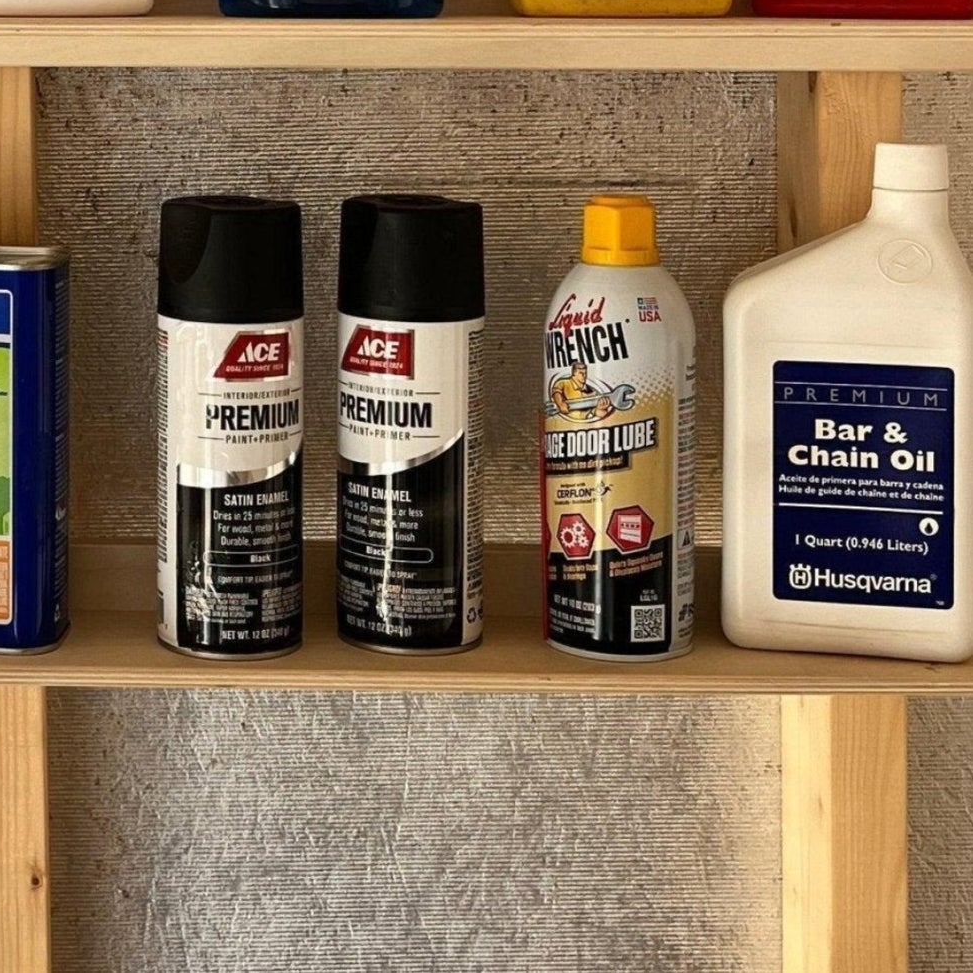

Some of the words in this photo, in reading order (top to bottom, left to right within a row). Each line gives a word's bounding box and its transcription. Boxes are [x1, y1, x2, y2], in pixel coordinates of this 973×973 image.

[548, 293, 605, 339] Liquid
[639, 311, 662, 323] USA
[237, 342, 281, 363] ACE
[357, 335, 400, 359] ACE
[784, 387, 938, 407] PREMIUM
[206, 398, 299, 431] PREMIUM
[340, 391, 432, 428] PREMIUM
[567, 428, 610, 458] DOOR
[613, 419, 655, 452] LUBE
[814, 418, 873, 442] Bar
[883, 422, 908, 443] &
[787, 445, 879, 468] Chain
[890, 449, 935, 472] Oil
[348, 482, 369, 497] SATIN
[779, 474, 807, 483] Aceite
[809, 475, 820, 483] de
[821, 475, 857, 486] primera
[858, 478, 878, 488] para
[879, 478, 903, 488] barra
[905, 481, 911, 489] y
[913, 480, 944, 490] cadena
[224, 494, 253, 506] SATIN
[257, 490, 289, 505] ENAMEL
[556, 488, 592, 499] CERFLON
[779, 485, 803, 493] Huile
[804, 486, 816, 494] de
[818, 487, 842, 497] guide
[844, 488, 856, 496] de
[889, 490, 899, 499] et
[900, 490, 913, 499] de
[213, 509, 232, 520] Dries
[243, 510, 252, 520] 25
[408, 507, 423, 517] less
[399, 521, 419, 530] more
[221, 536, 251, 546] Durable,
[395, 532, 416, 542] finish
[804, 534, 843, 548] Quart
[845, 536, 884, 551] (0.946
[887, 539, 929, 555] Liters)
[250, 554, 271, 563] Black
[814, 568, 932, 594] Husqvarna
